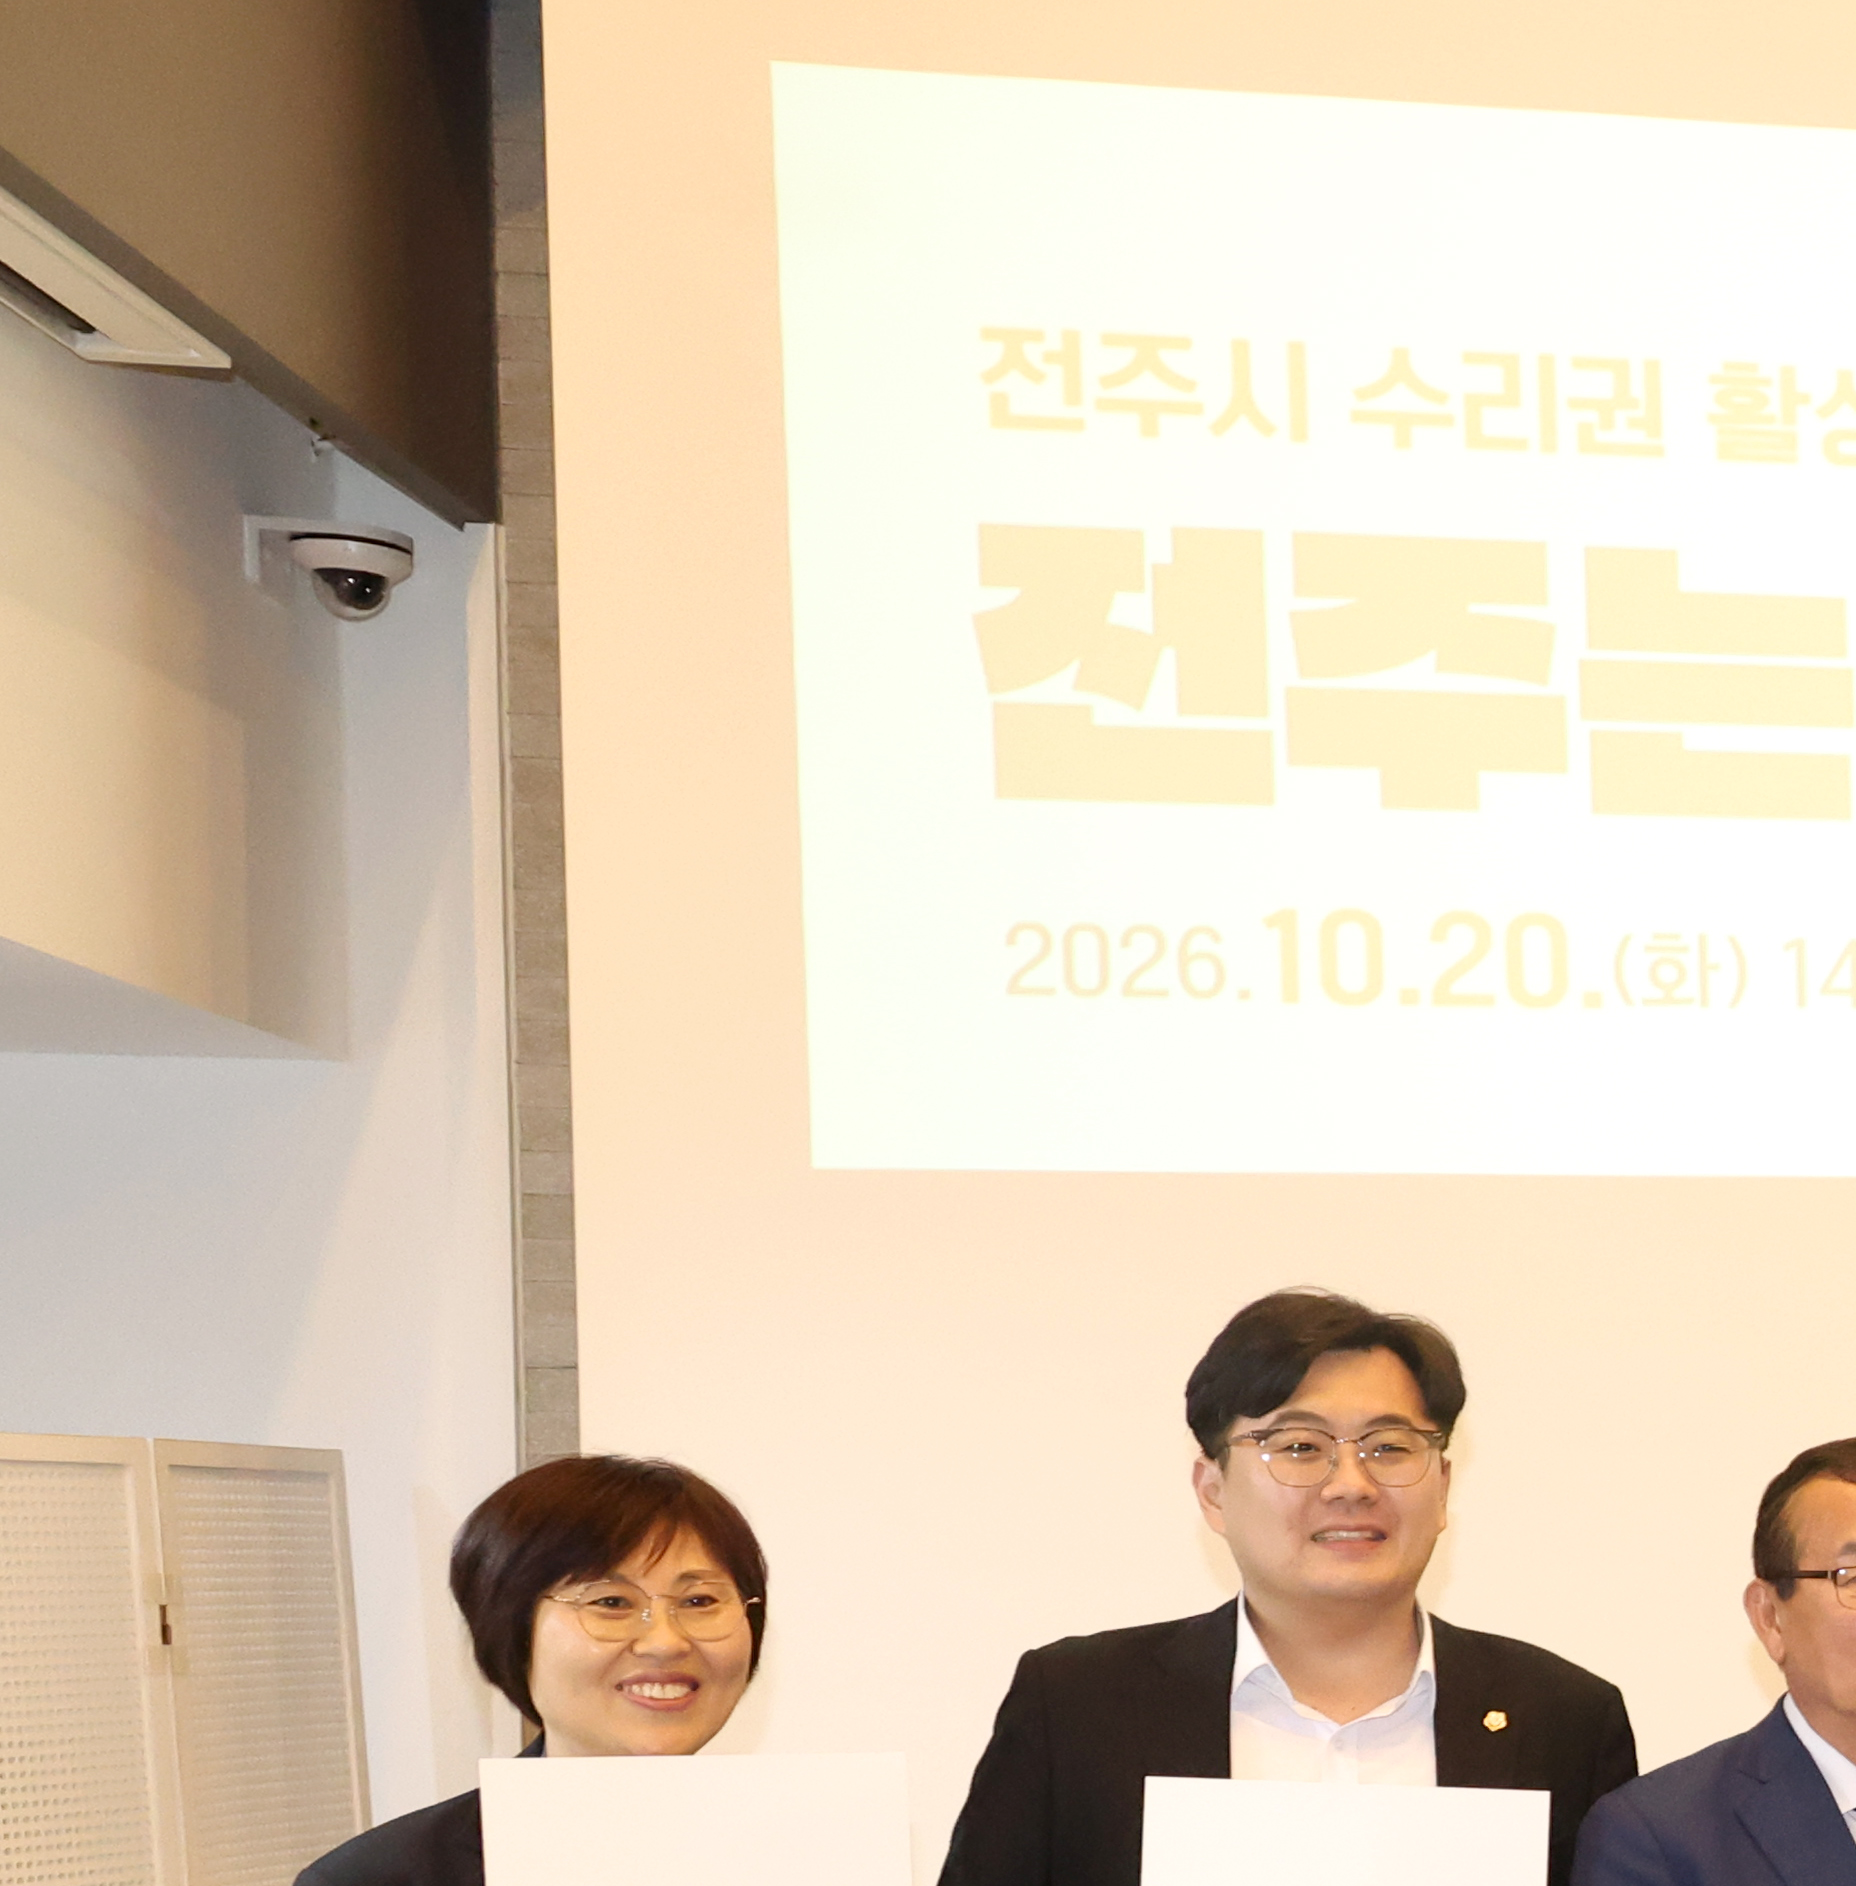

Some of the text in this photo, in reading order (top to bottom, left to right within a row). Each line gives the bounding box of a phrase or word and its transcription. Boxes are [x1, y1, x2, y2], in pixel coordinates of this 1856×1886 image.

[978, 324, 1311, 444] 전주시
[1349, 346, 1666, 459] 수리권
[971, 521, 1856, 821] 전주는
